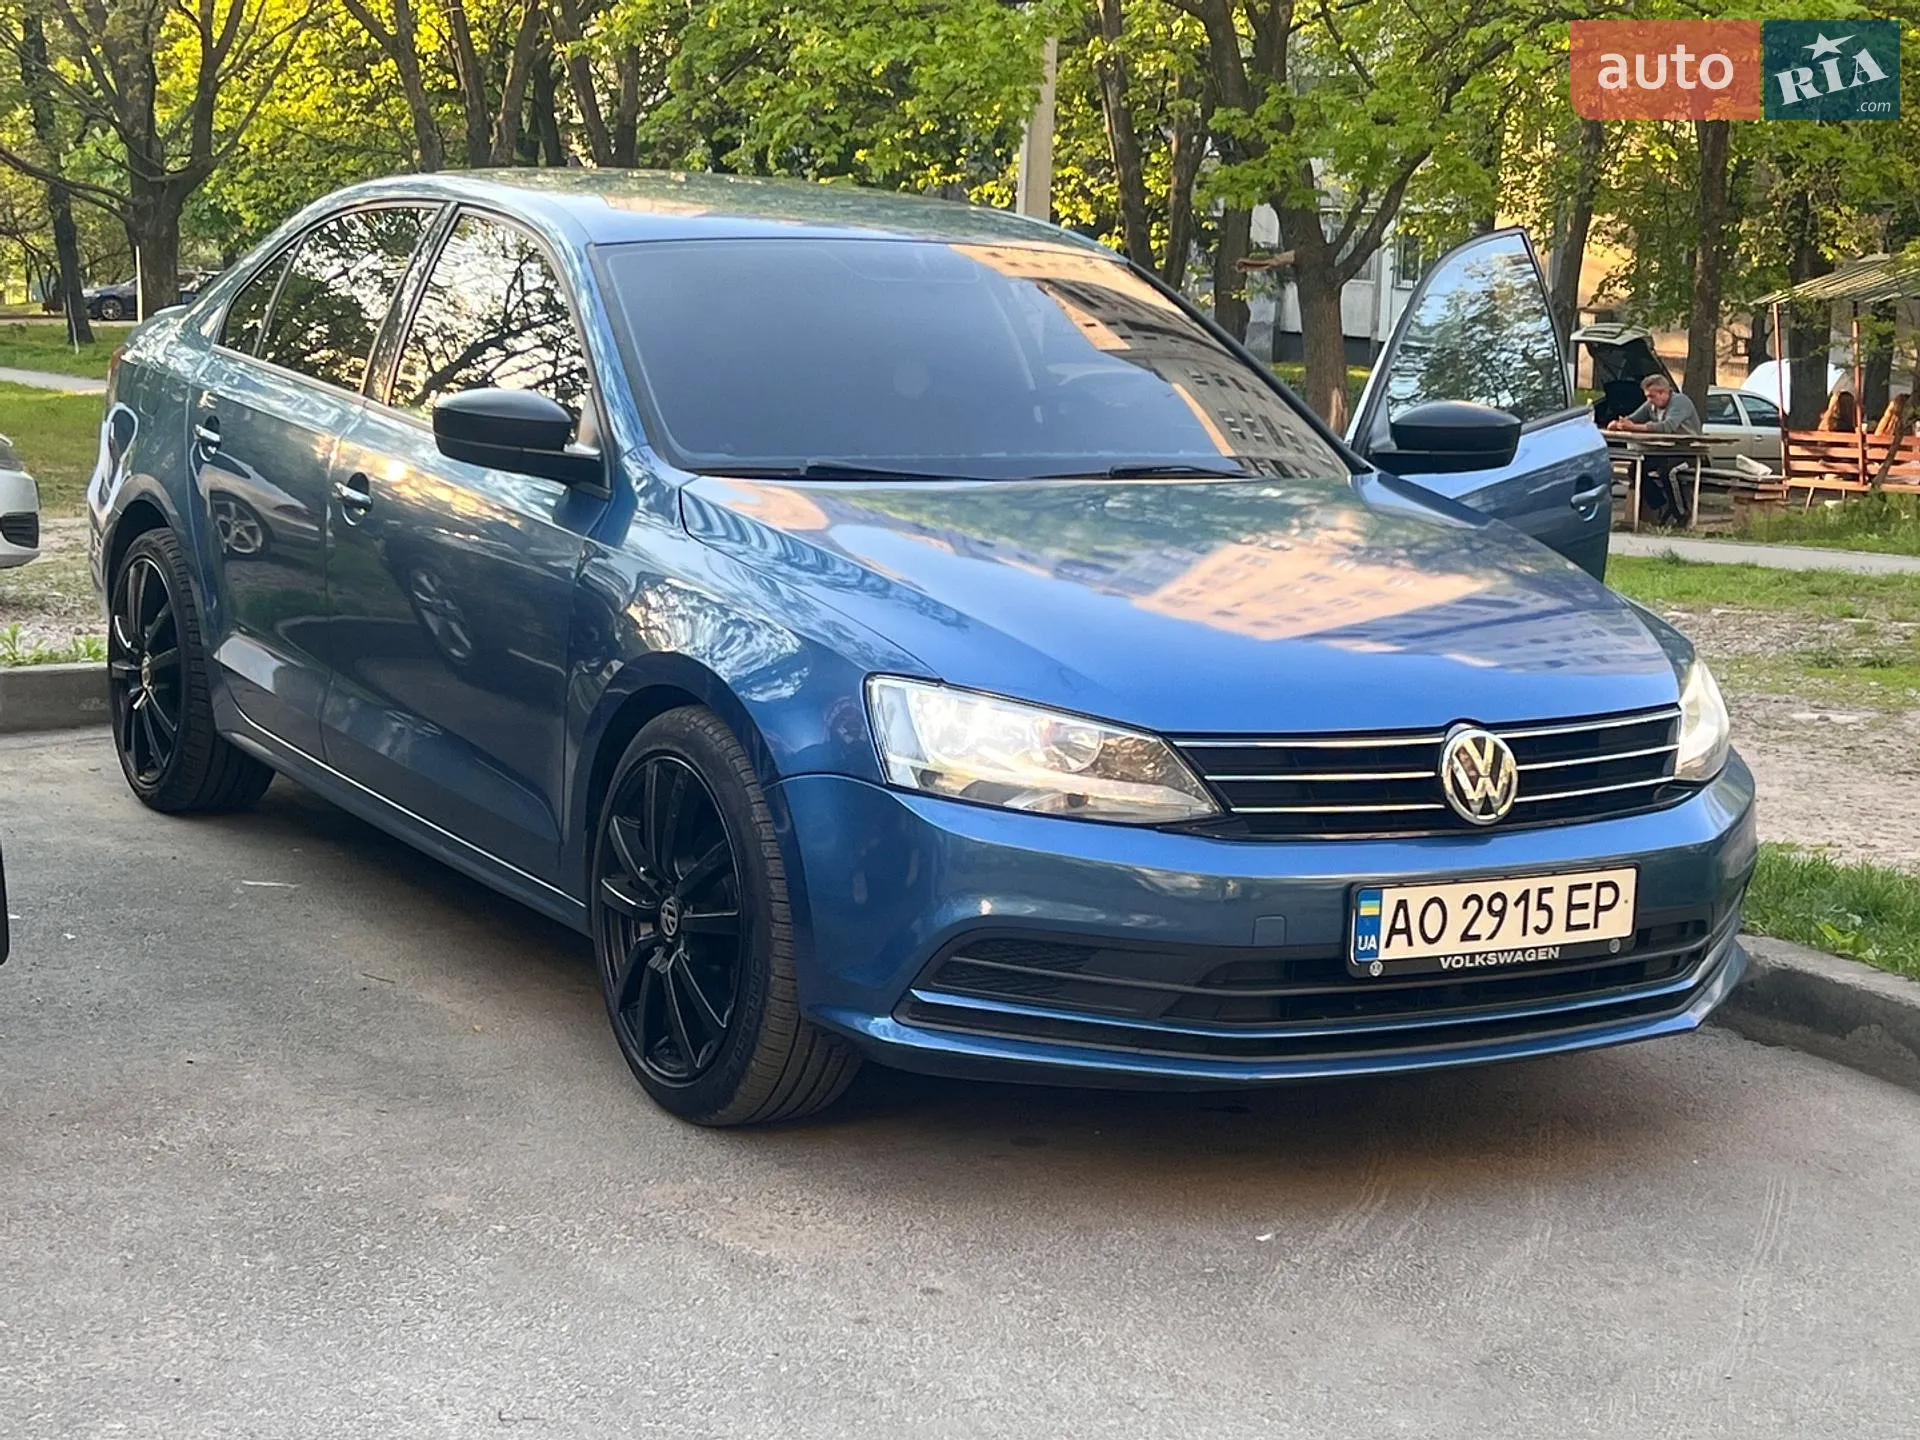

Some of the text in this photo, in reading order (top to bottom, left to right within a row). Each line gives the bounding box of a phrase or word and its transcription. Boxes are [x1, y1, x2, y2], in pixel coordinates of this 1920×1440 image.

[1384, 880, 1620, 949] AO 2915 EP
[1358, 934, 1377, 951] UA
[1440, 946, 1560, 970] VOLKSWAGEN
